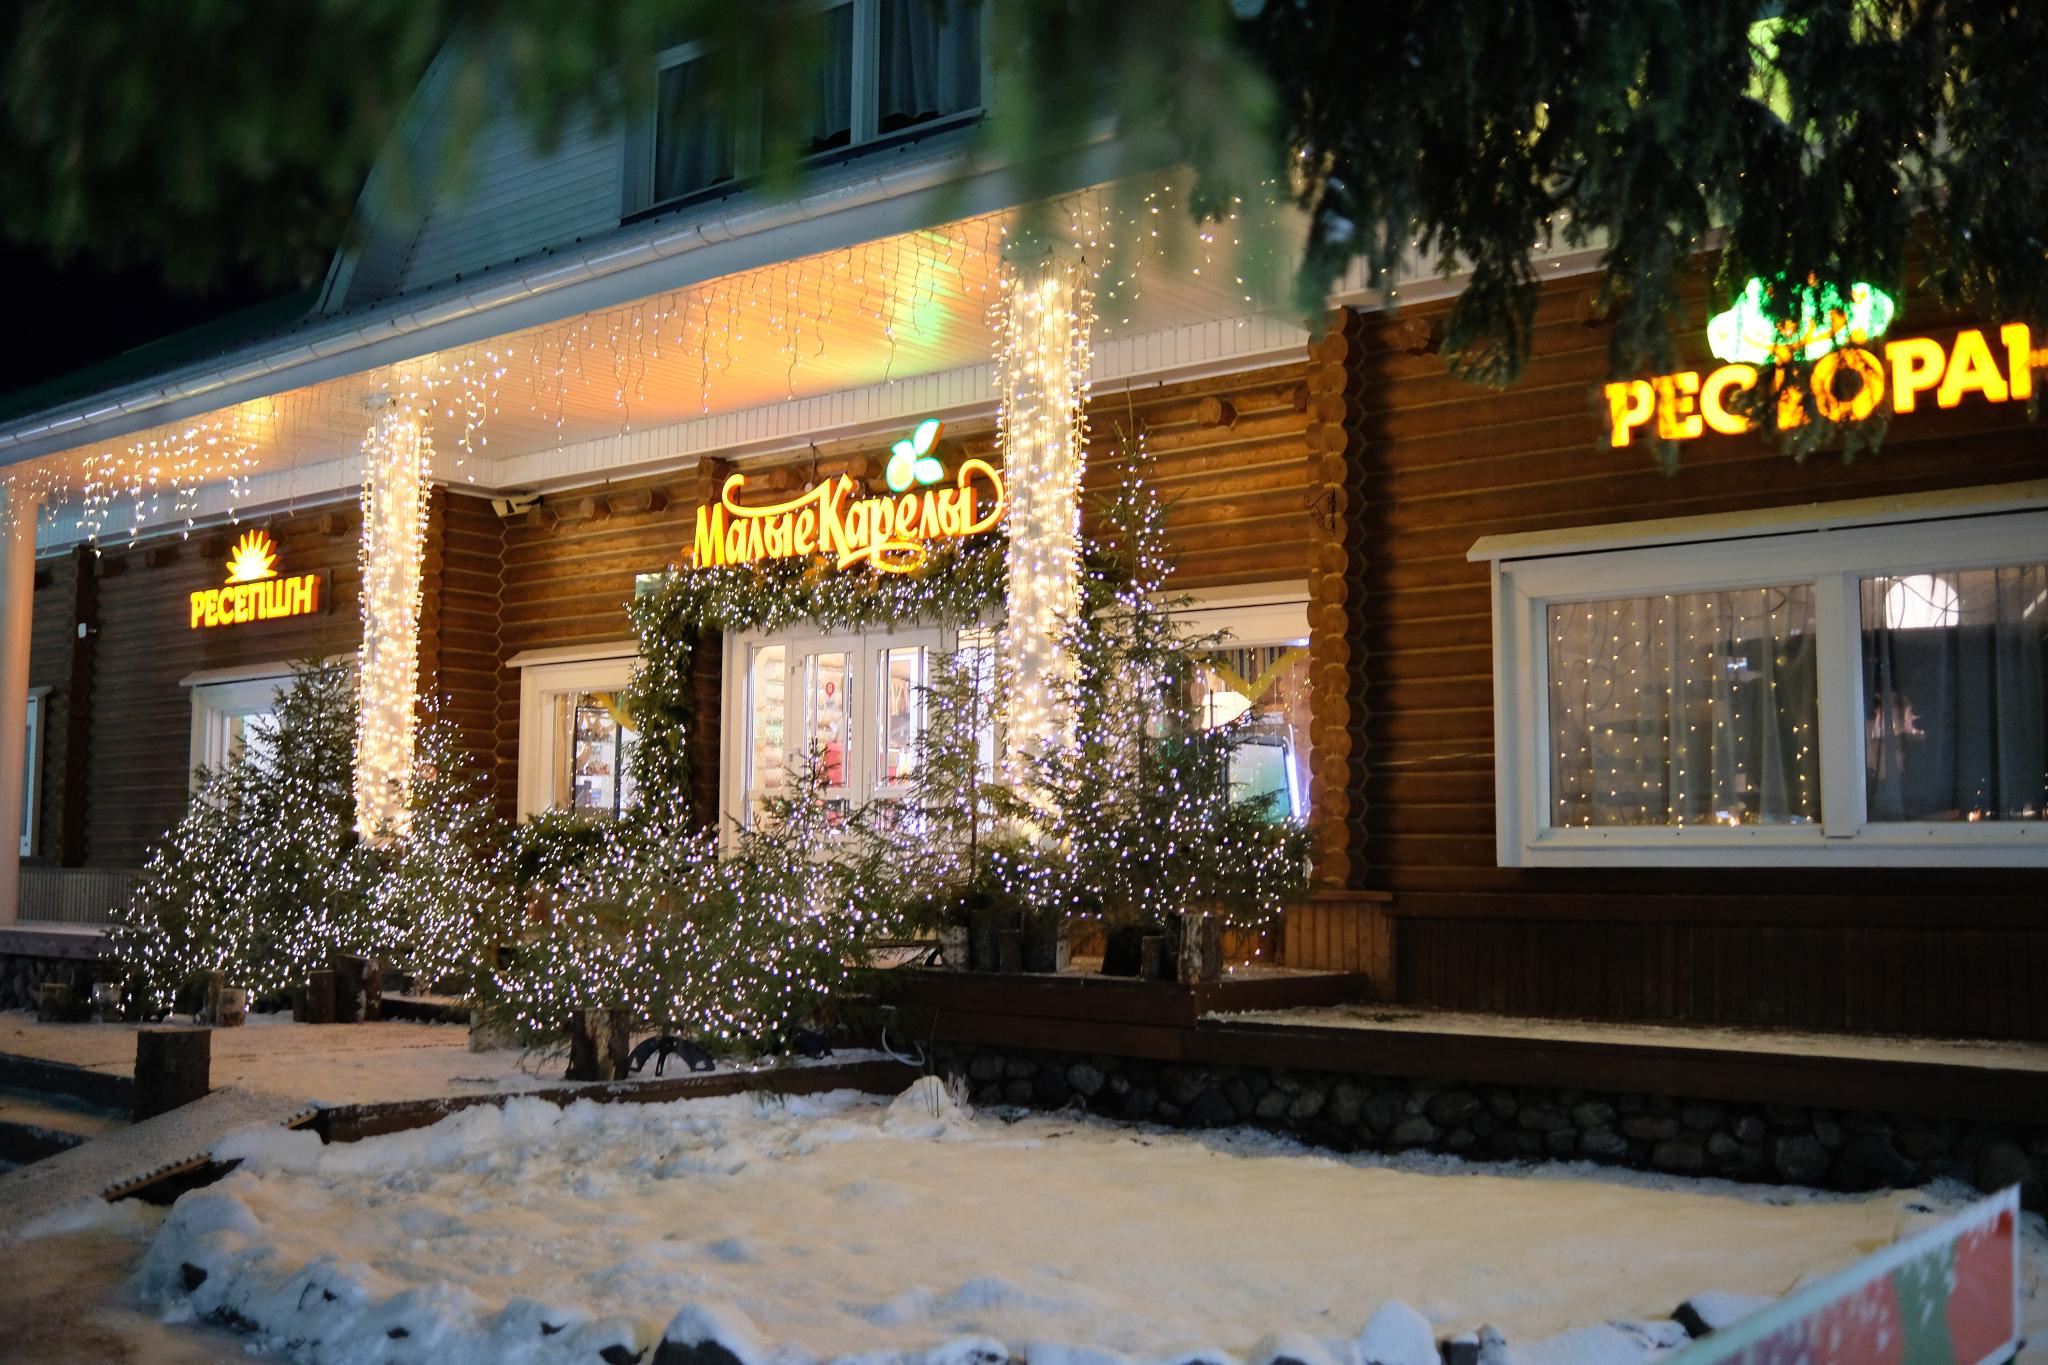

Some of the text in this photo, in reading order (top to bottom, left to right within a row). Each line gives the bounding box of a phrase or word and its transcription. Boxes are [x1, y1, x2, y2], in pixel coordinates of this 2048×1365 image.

[693, 459, 1004, 573] Малые Карелы
[190, 574, 316, 629] РЕСЕПШН
